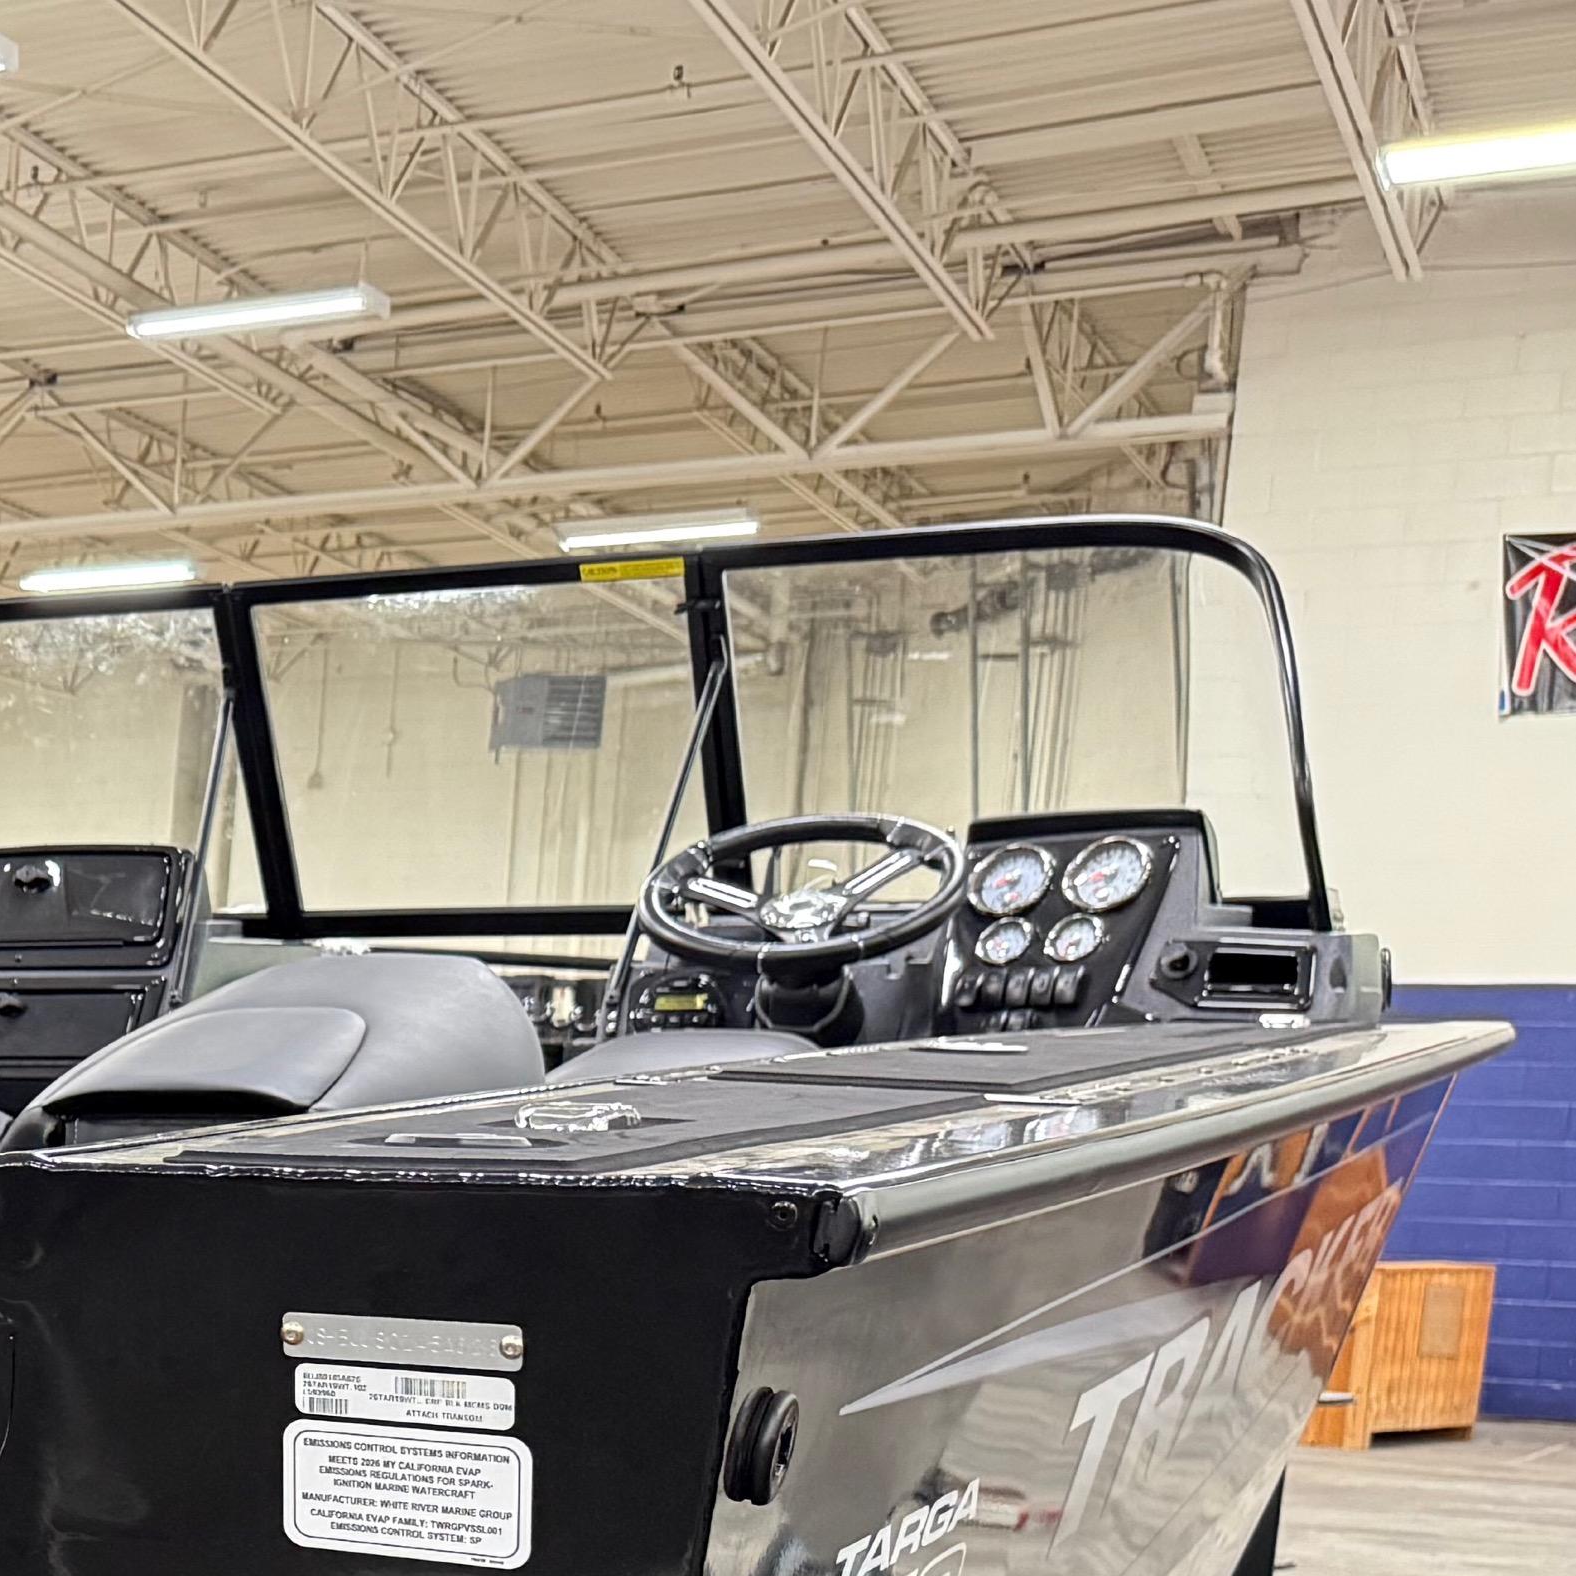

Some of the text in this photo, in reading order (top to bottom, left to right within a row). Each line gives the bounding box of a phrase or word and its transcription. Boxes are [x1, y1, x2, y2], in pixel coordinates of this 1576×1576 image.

[303, 1437, 509, 1464] EMISSIONS CONTROL SYSTEMS INFORMATION
[328, 1455, 357, 1465] MEETS
[383, 1460, 395, 1469] MY
[398, 1461, 453, 1474] CALIFORNIA
[456, 1466, 480, 1476] EVAP
[319, 1465, 493, 1489] EMISSIONS REGULATIONS FOR SPARK-
[333, 1478, 475, 1499] IGNITION MARINE WATERCRAFT
[302, 1491, 512, 1520] MANUFACTURER: WHITE RIVER MARINE GROUP
[310, 1508, 362, 1521] CALIFORNIA
[366, 1513, 389, 1524] EVAP
[392, 1516, 427, 1528] FAMILY:
[330, 1522, 378, 1534] EMISSIONS
[381, 1527, 424, 1539] CONTROL
[427, 1531, 466, 1543] SYSTEM:
